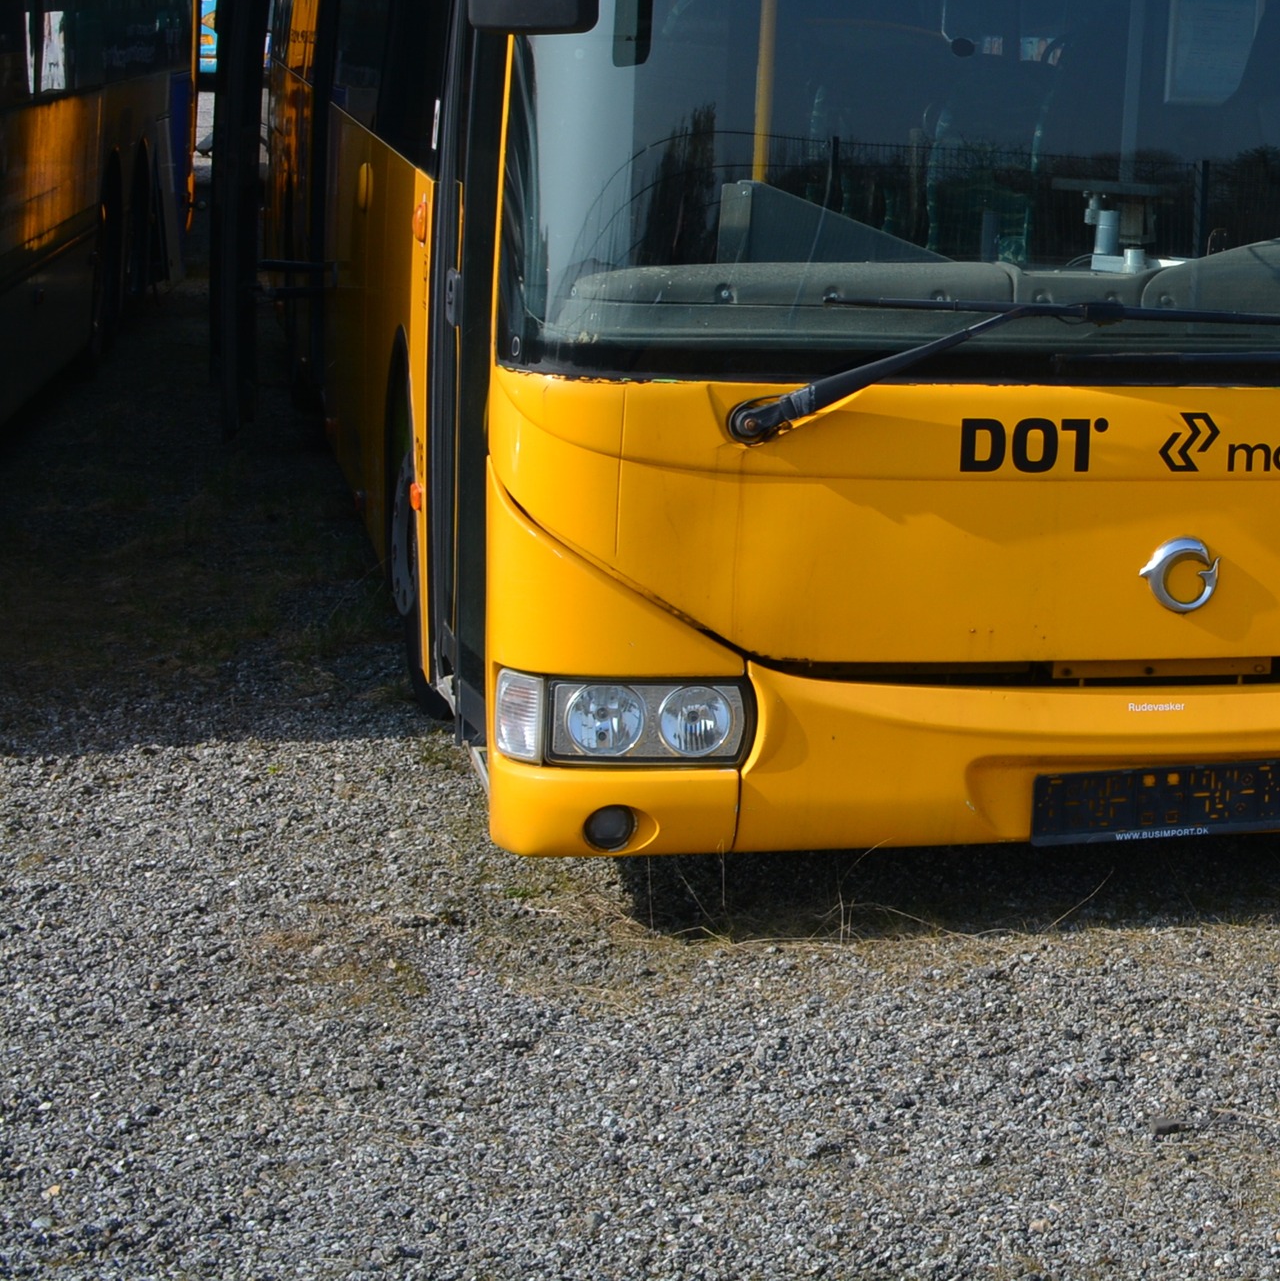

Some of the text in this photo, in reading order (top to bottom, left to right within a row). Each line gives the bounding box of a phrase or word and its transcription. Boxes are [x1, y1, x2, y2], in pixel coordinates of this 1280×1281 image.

[959, 417, 1109, 473] DOT
[1128, 702, 1185, 712] Rudevasker
[1115, 827, 1209, 841] WWW.BUSIMPORT.DK
